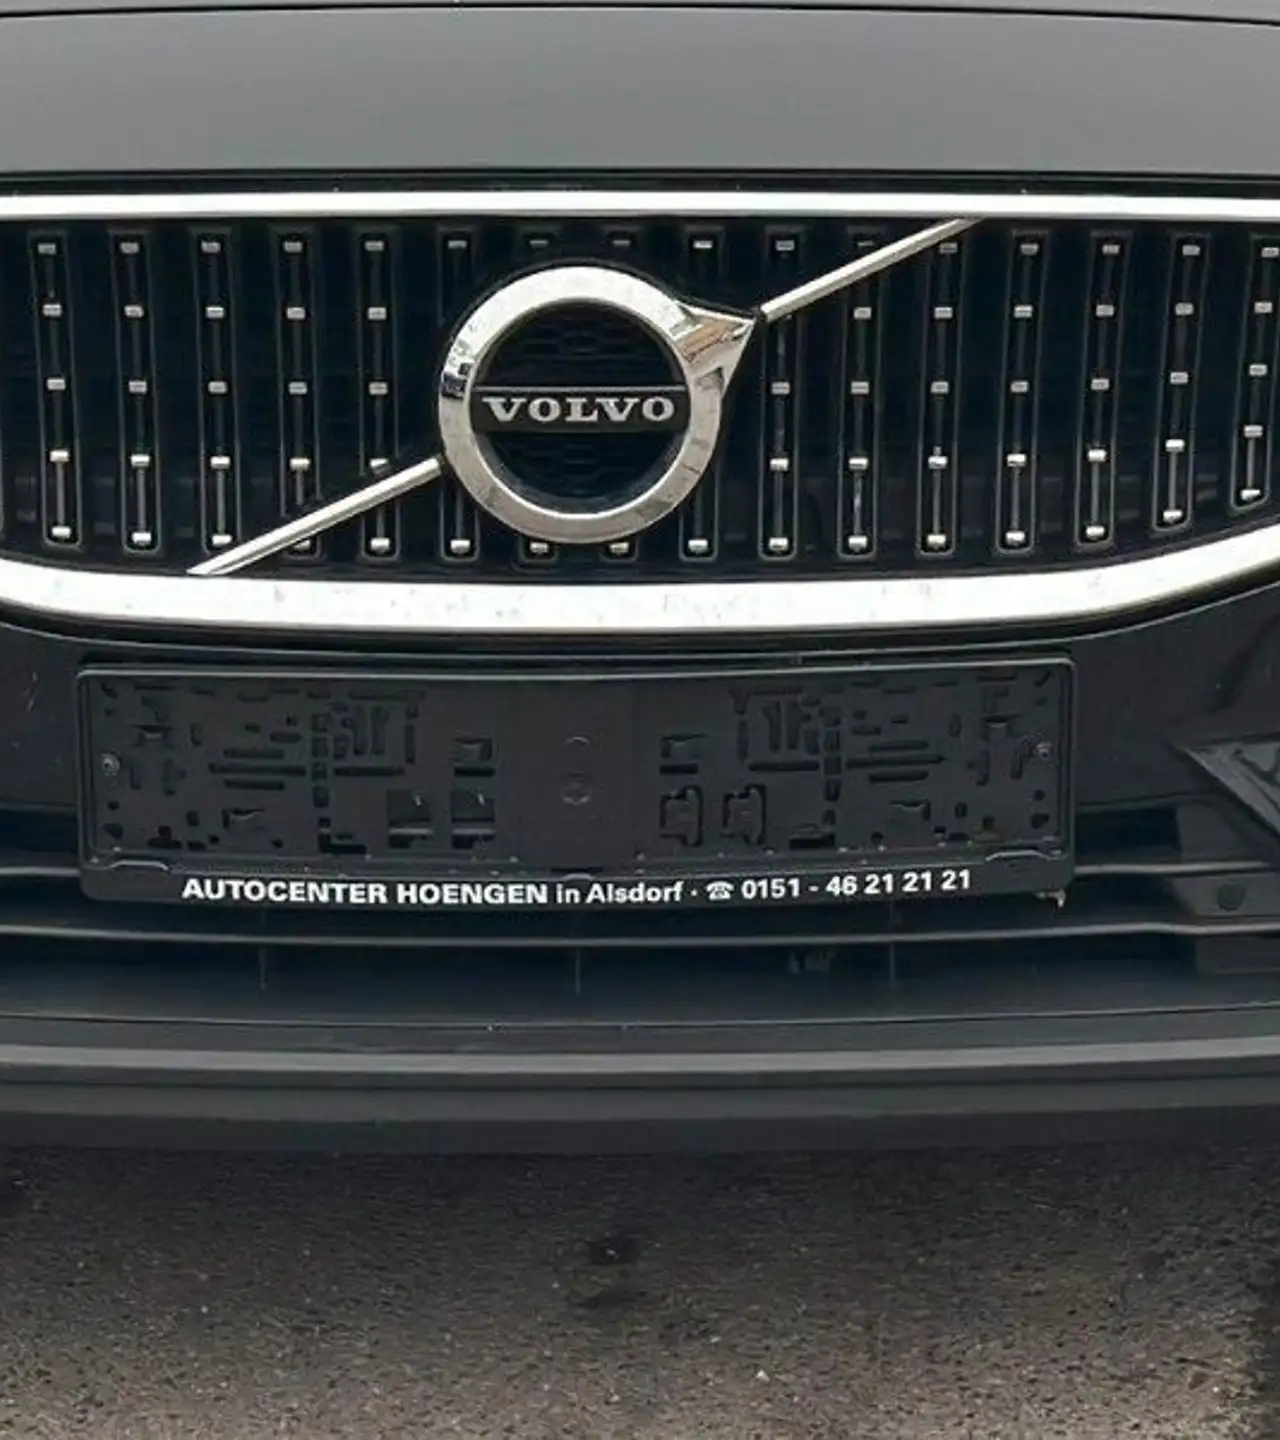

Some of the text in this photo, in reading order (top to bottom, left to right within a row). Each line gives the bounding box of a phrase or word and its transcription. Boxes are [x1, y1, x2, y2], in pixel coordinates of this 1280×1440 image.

[482, 396, 674, 422] VOLVO
[181, 878, 389, 904] AUTOCENTER
[396, 883, 548, 905] HOENGEN
[556, 883, 581, 904] in
[585, 879, 685, 904] Alsdorf
[740, 877, 800, 900] 0151
[825, 874, 858, 897] 46
[863, 872, 894, 895] 21
[901, 870, 932, 893] 21
[940, 868, 970, 891] 21
